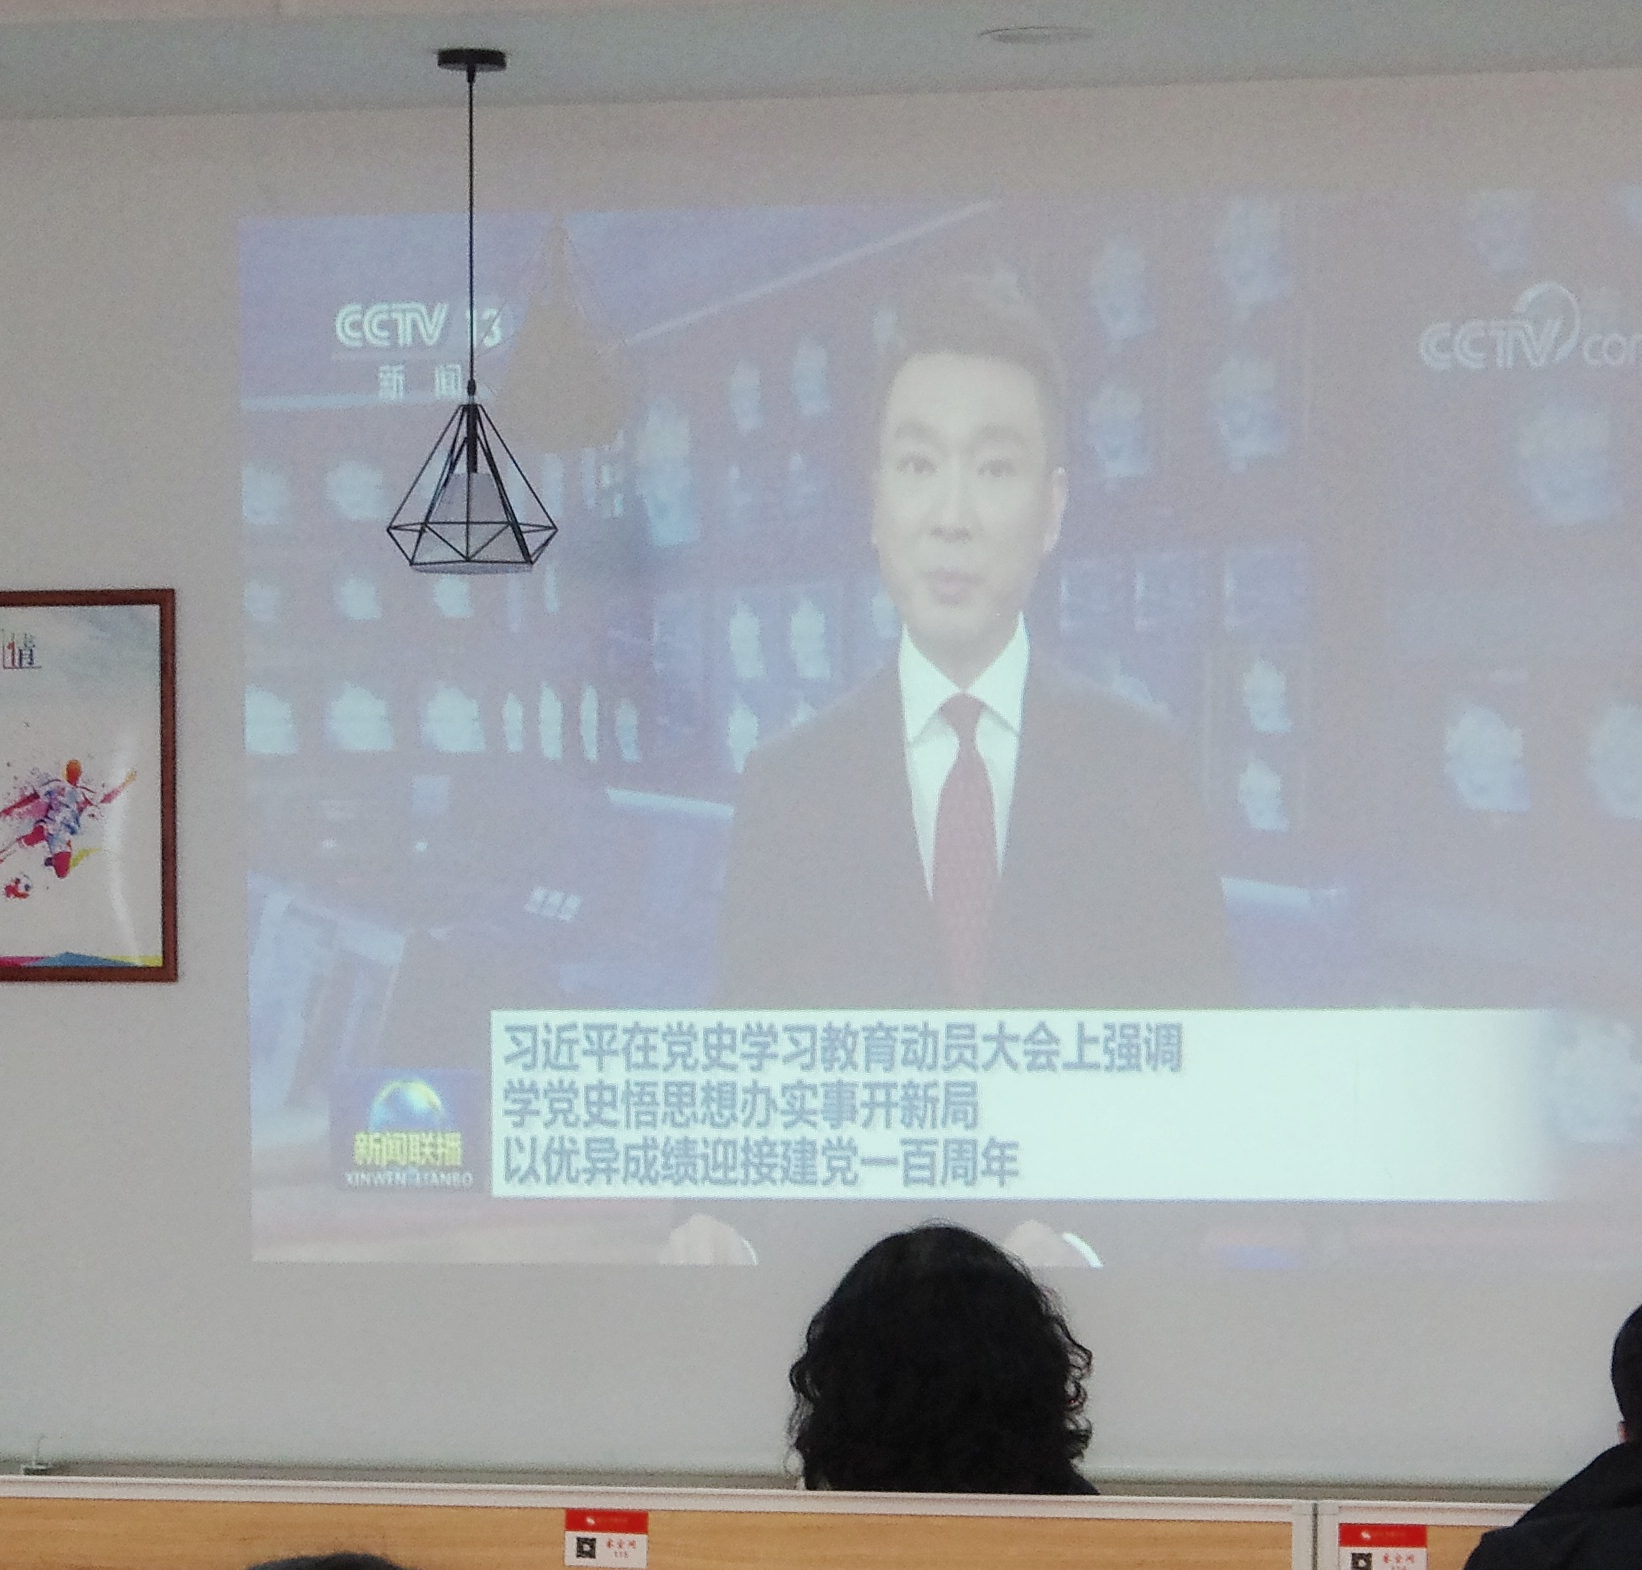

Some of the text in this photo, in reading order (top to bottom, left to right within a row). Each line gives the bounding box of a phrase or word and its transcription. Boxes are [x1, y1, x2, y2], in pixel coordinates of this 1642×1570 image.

[335, 302, 449, 348] CCTV
[379, 363, 461, 400] 新闻
[503, 1021, 1184, 1072] 习近平在党史学习教育动员大会上强调
[503, 1079, 979, 1130] 学党史悟思想办实事开新局
[354, 1130, 462, 1167] 新闻联播
[504, 1135, 1020, 1188] 以优异成绩迎接建党一百周年
